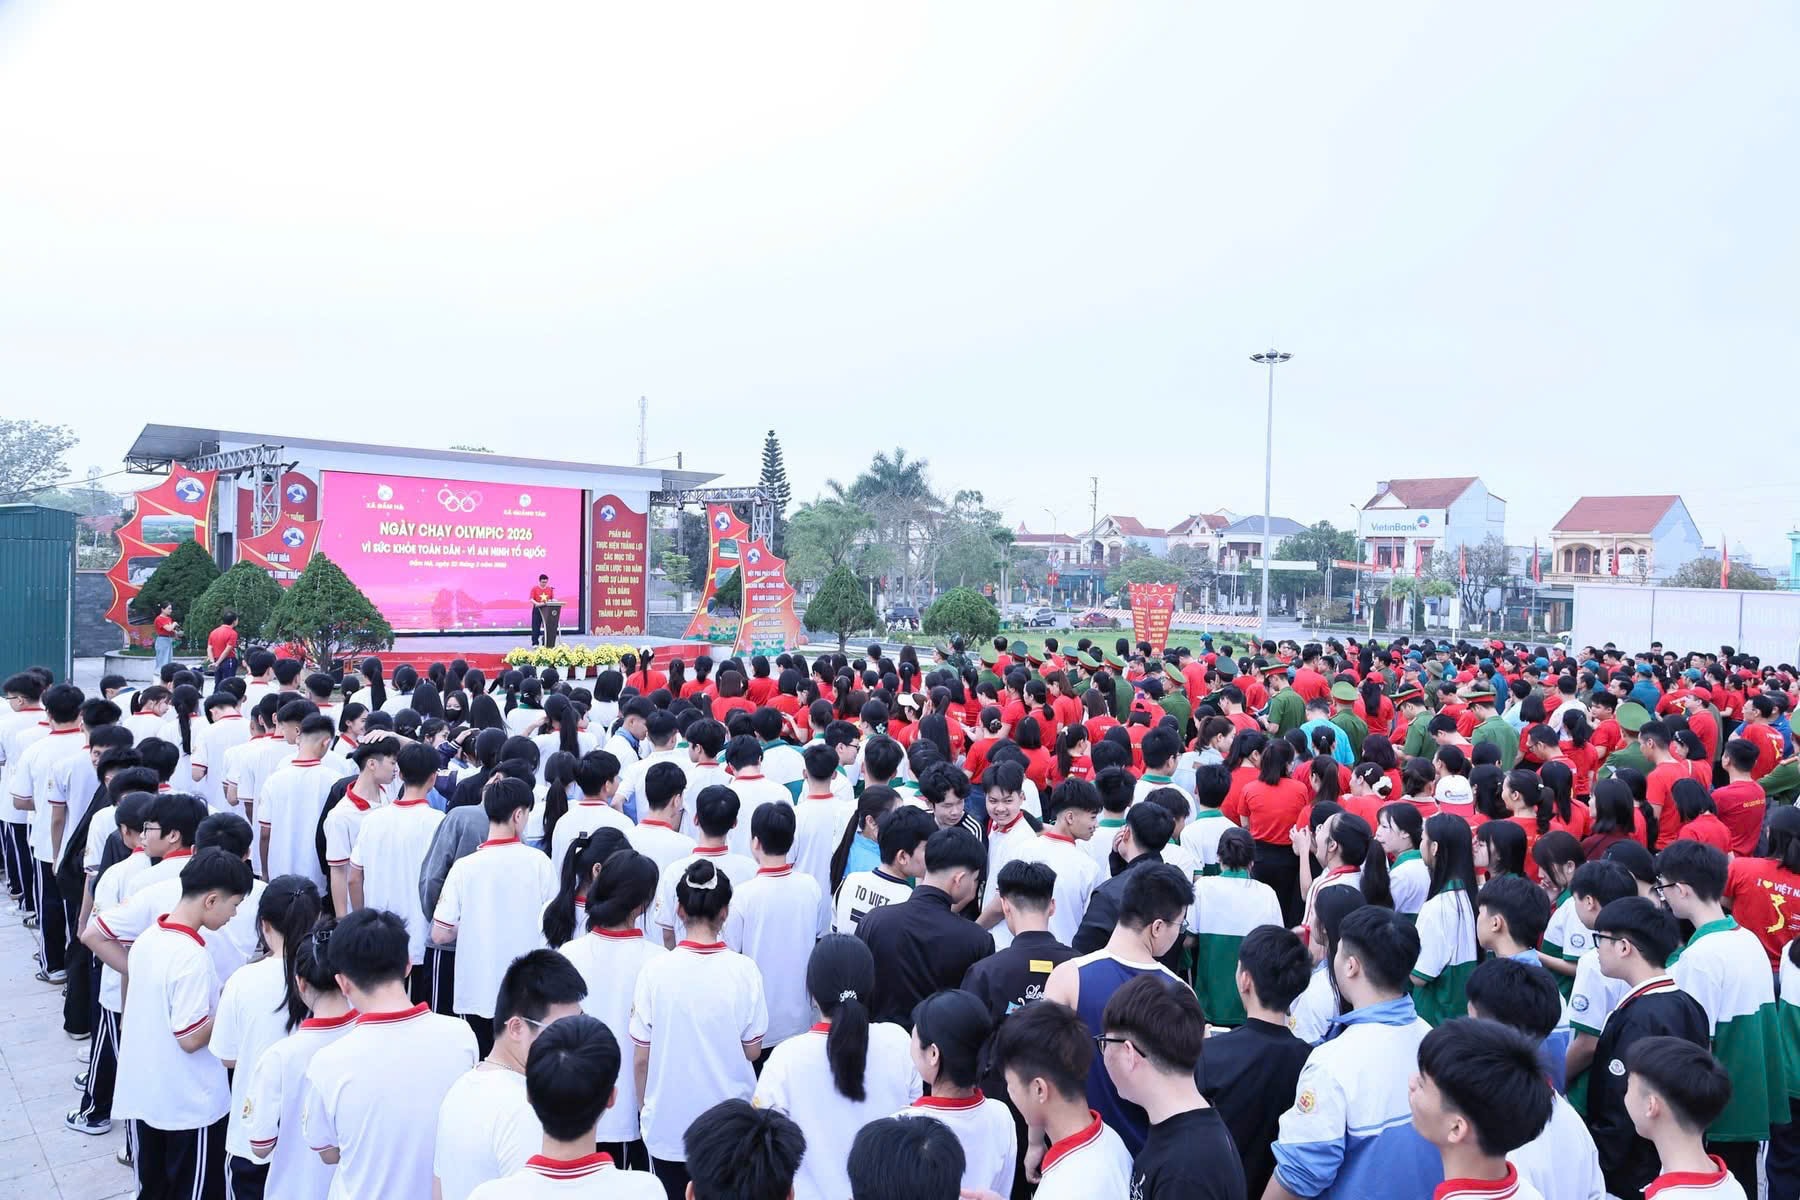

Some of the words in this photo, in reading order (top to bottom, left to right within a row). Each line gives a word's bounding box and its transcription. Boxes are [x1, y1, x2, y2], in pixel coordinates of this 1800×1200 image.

[380, 520, 416, 536] NGÀY
[418, 524, 452, 540] CHẠY
[454, 525, 504, 540] OLYMPIC
[507, 528, 533, 540] 2026
[1371, 522, 1417, 531] VietinBank
[362, 540, 371, 552] VÌ
[373, 541, 390, 552] SỨC
[393, 542, 416, 554] KHỎE
[418, 542, 441, 554] TOÀN
[443, 544, 460, 555] DÂN
[468, 544, 475, 556] VÌ
[477, 547, 486, 556] AN
[490, 547, 510, 556] NINH
[512, 544, 521, 557] TỔ
[523, 545, 546, 559] QUỐC
[855, 885, 867, 901] TO
[1774, 882, 1792, 895] VIỆT
